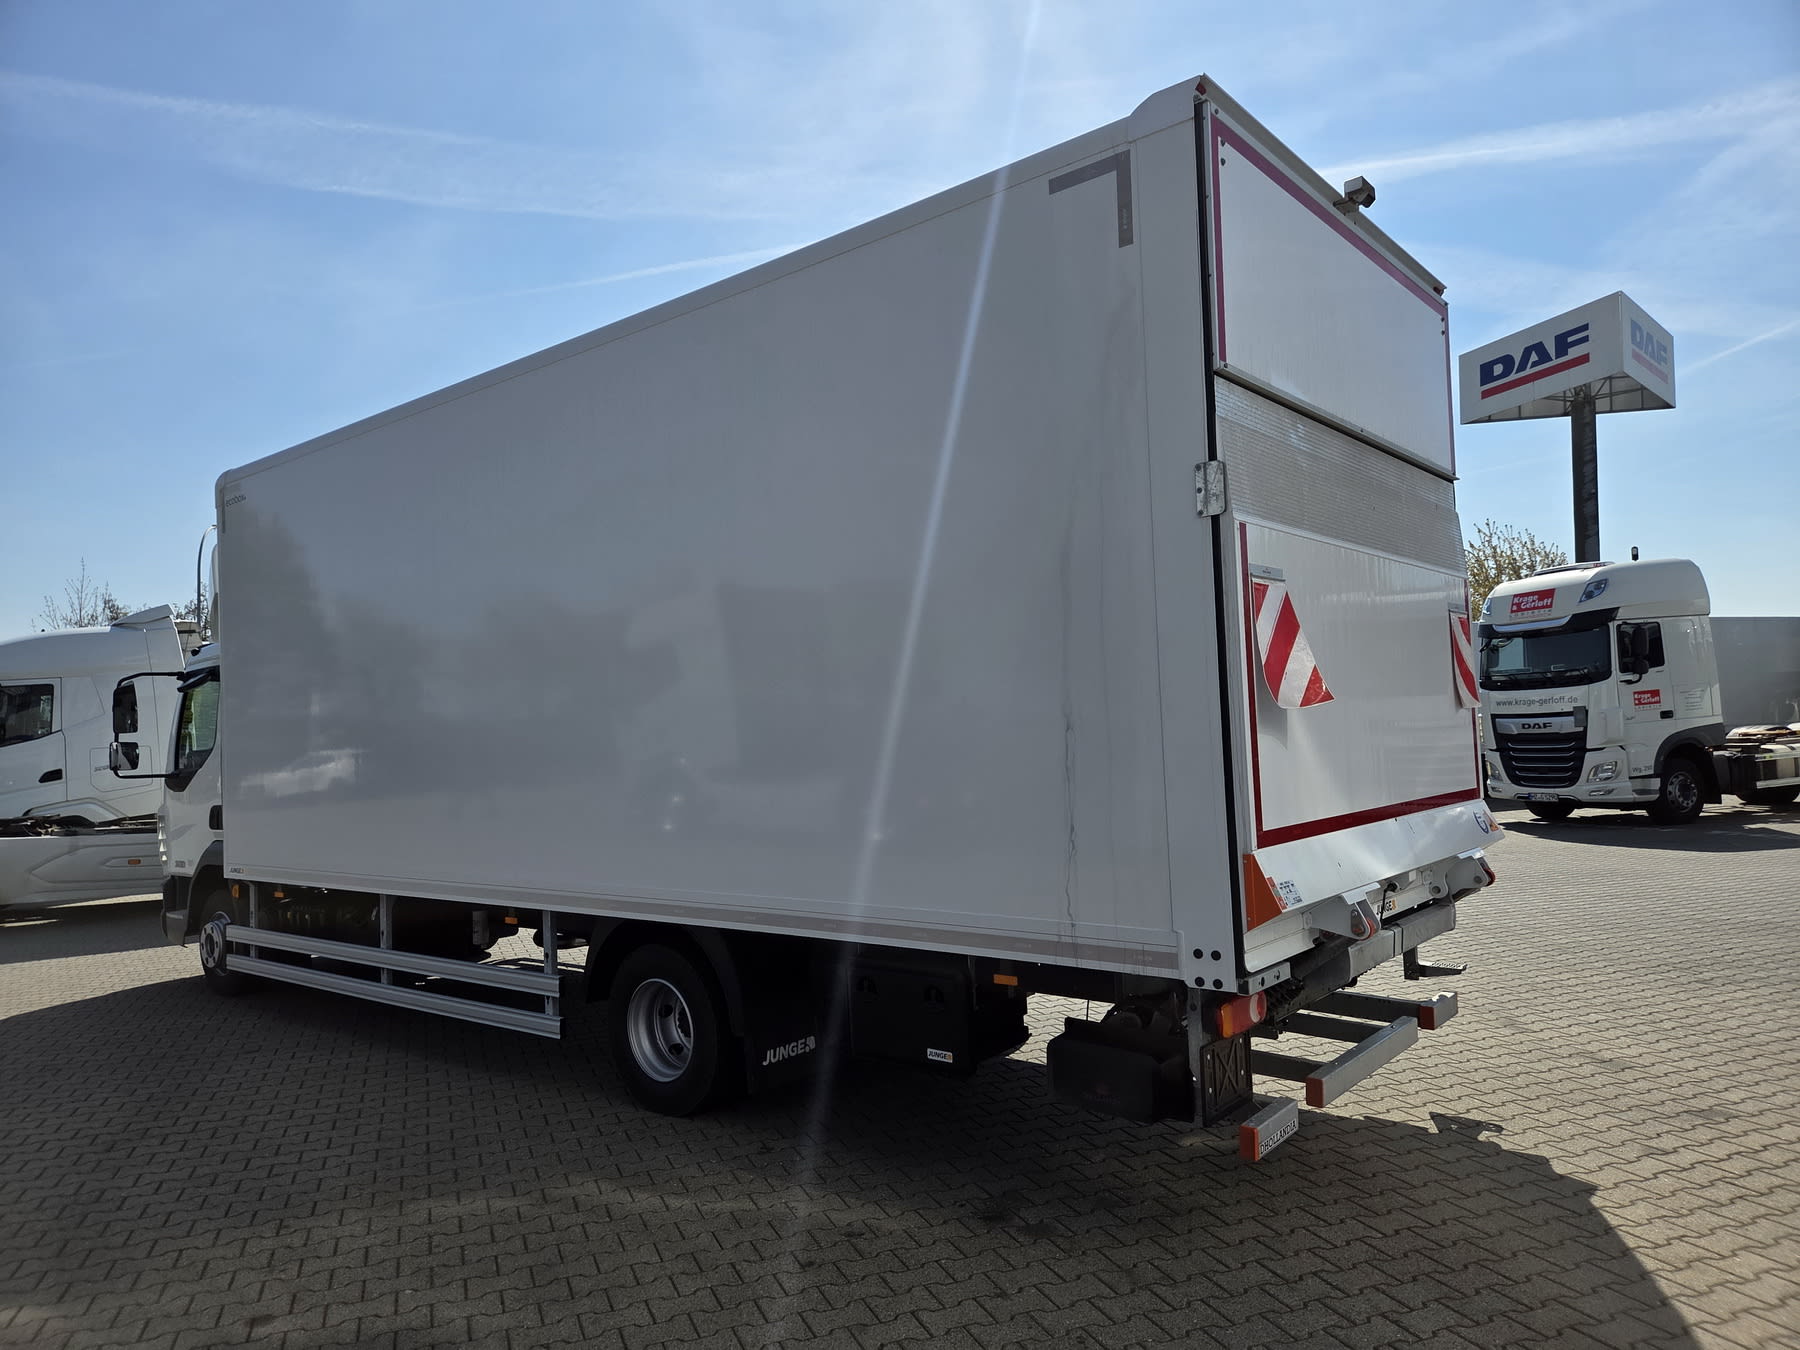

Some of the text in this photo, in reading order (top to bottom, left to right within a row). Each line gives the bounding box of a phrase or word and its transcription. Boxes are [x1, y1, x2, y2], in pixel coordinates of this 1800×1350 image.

[1630, 319, 1668, 366] DAF
[1480, 323, 1589, 387] DAF
[1513, 595, 1538, 604] Krage
[1520, 597, 1552, 609] Gerloff
[1495, 696, 1578, 707] www.krage-gerloff.de
[1521, 722, 1552, 730] DAF
[762, 1038, 805, 1066] JUNGE
[928, 1050, 947, 1060] JUNGE
[1260, 1120, 1297, 1155] DHOLLANDIA
